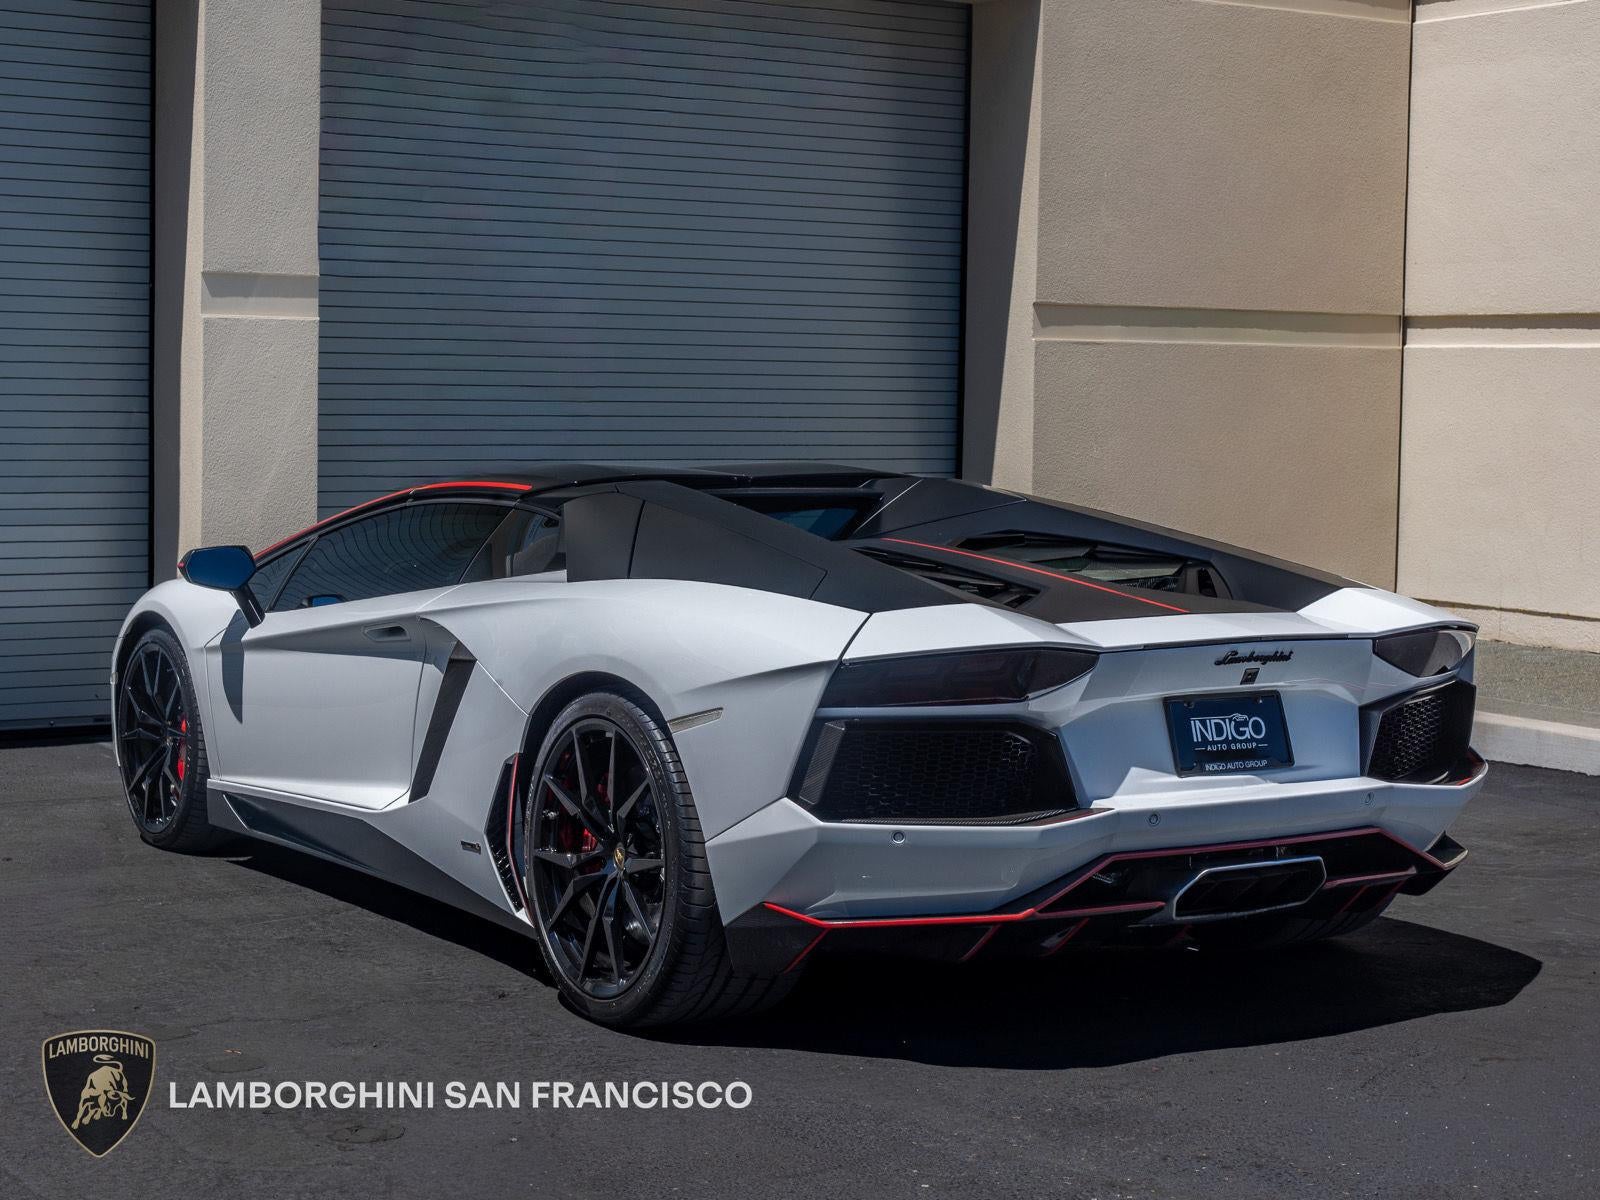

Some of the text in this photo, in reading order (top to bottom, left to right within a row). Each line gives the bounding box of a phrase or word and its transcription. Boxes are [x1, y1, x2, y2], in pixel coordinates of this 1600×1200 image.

[1190, 716, 1266, 742] INDIGO
[1206, 742, 1257, 751] AUTO GROUP
[1205, 760, 1267, 771] INDIGO AUTO GROUP
